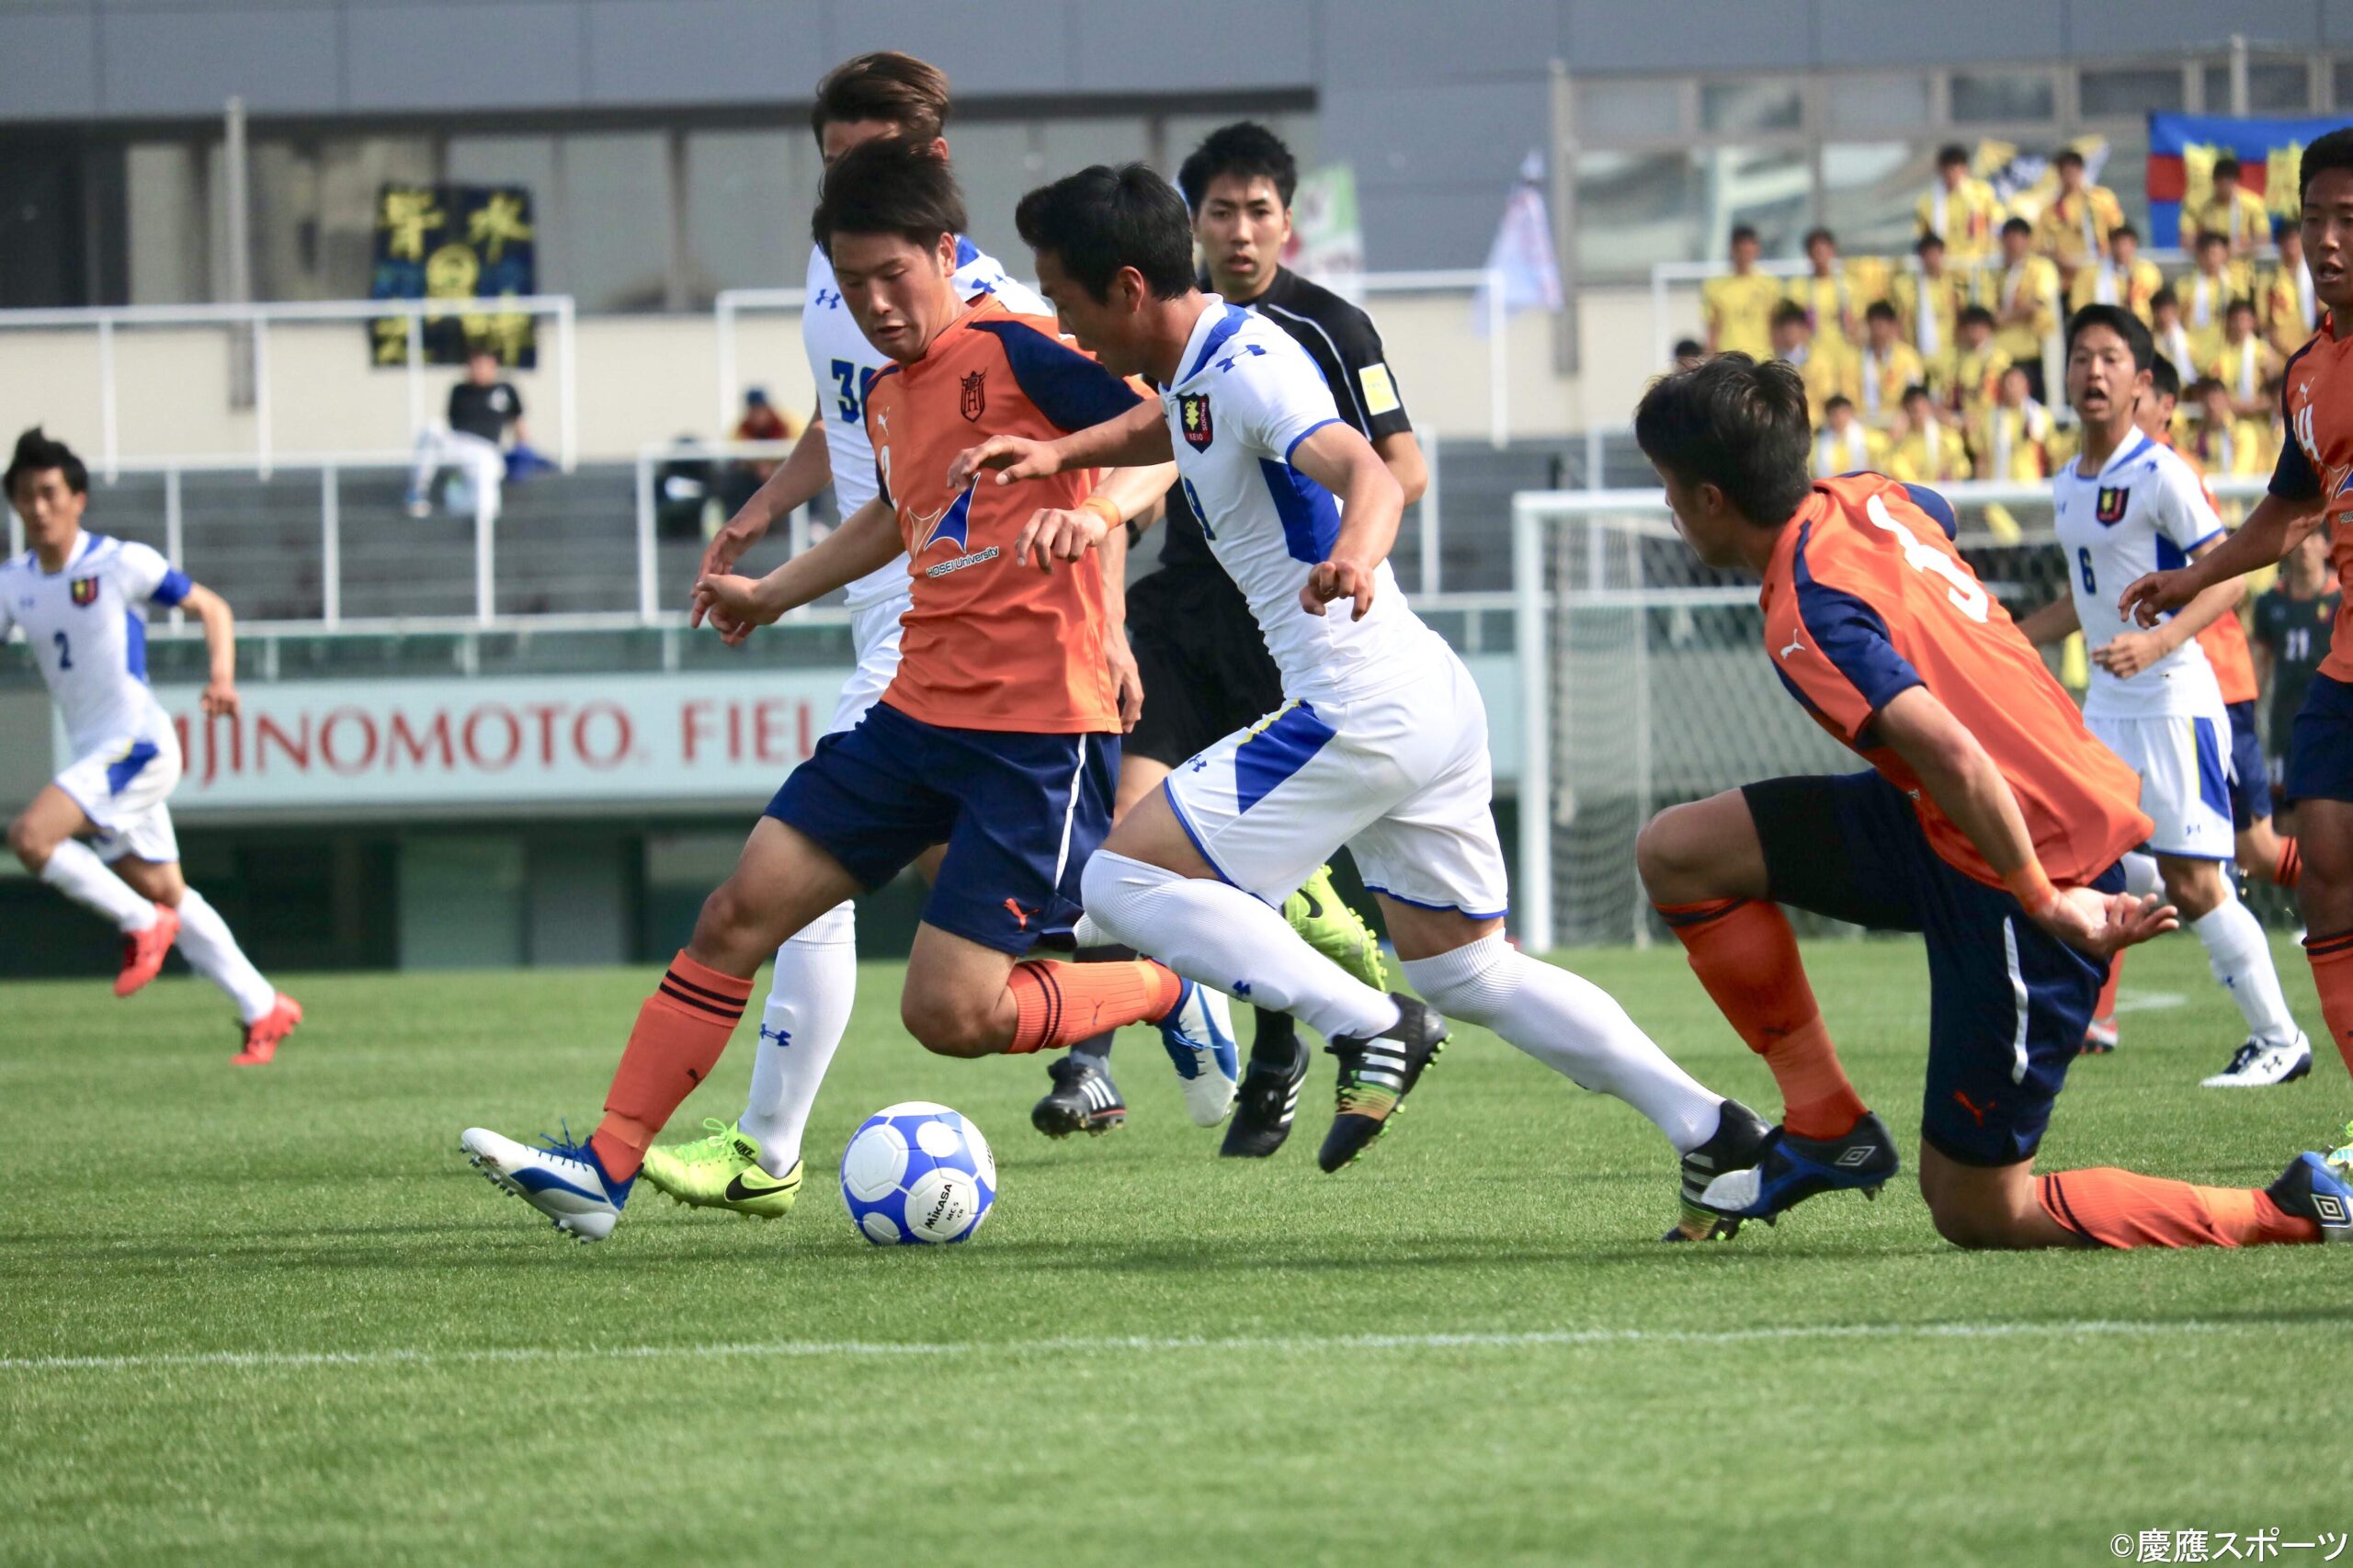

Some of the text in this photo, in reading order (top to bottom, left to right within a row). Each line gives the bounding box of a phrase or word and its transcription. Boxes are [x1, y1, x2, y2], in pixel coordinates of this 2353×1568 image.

[926, 546, 999, 578] HOSEI University
[2078, 546, 2097, 595] 6
[54, 631, 73, 671] 2
[174, 701, 632, 789] JINOMOTO
[733, 1139, 756, 1157] NIKE
